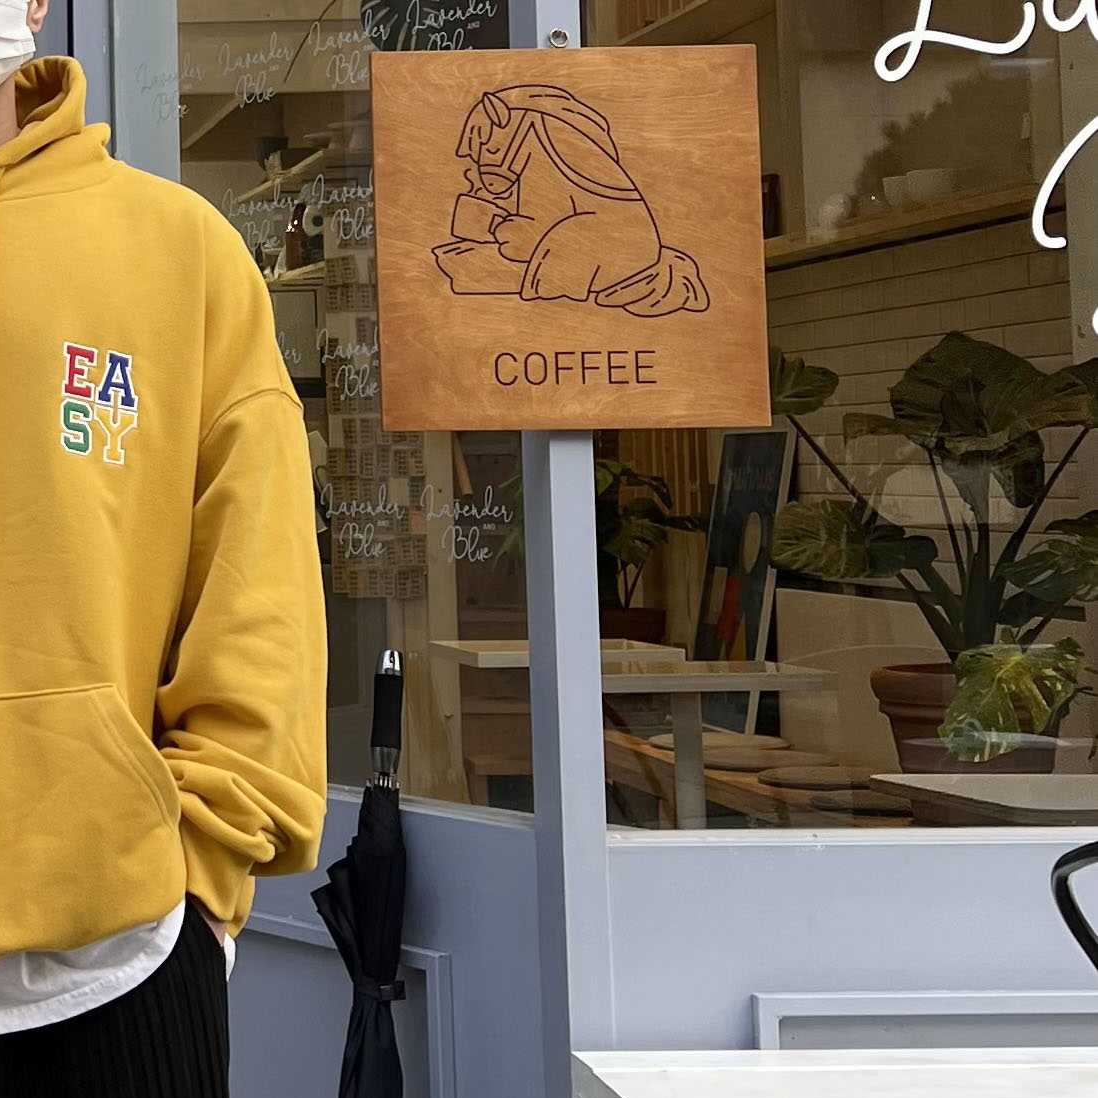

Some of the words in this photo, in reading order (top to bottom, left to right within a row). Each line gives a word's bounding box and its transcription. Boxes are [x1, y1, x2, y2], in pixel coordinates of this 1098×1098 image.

[308, 9, 391, 56] Lavender
[406, 0, 498, 34] Lavender
[218, 32, 293, 76] Lavender
[235, 71, 276, 109] Blue
[312, 168, 374, 208] Lavend
[332, 207, 374, 245] Blue
[316, 326, 379, 363] Lavend
[334, 364, 380, 400] Blue
[494, 350, 658, 386] COFFEE
[320, 483, 406, 519] Lavender
[420, 485, 514, 523] Lavender
[339, 522, 388, 559] Blue
[441, 526, 494, 563] Blue
